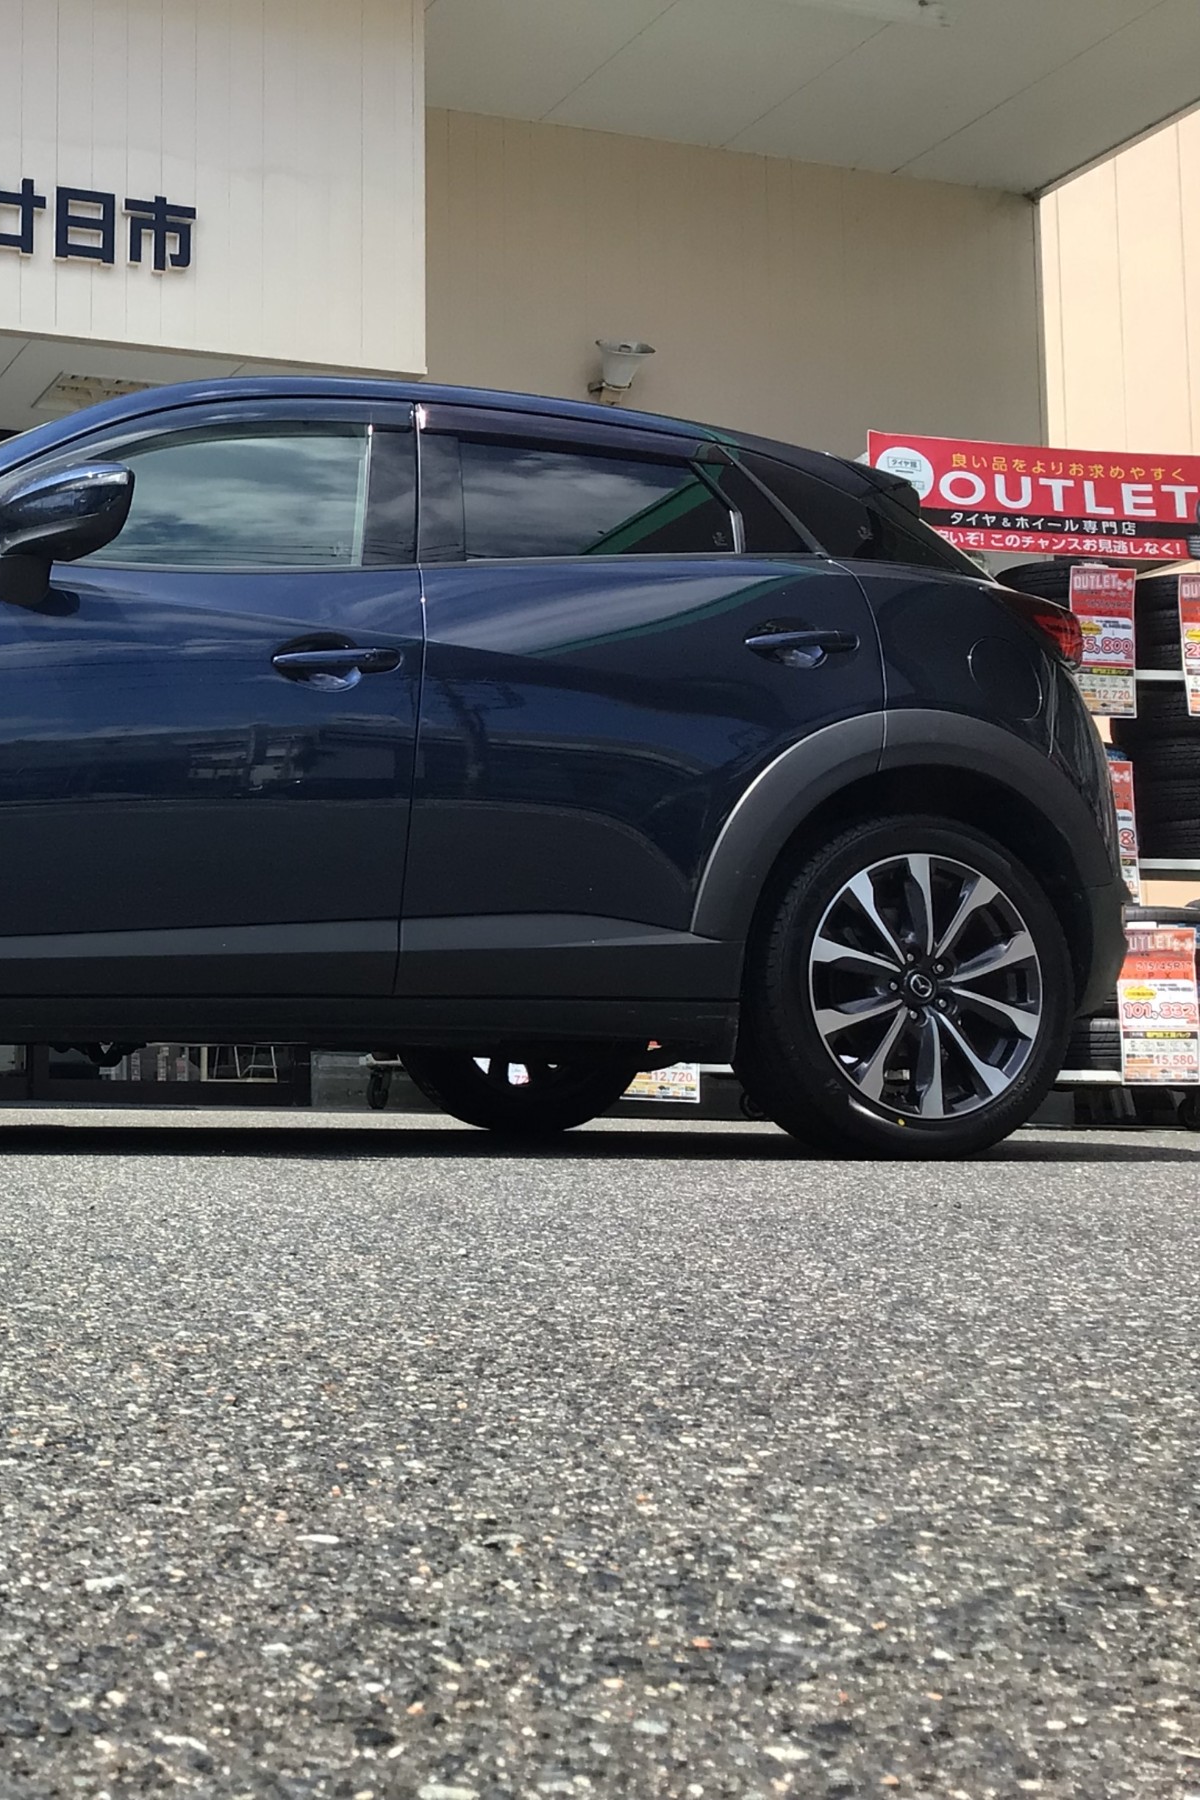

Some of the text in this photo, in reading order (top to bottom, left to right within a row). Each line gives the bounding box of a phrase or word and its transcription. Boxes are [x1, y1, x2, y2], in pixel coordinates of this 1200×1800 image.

[951, 452, 1185, 482] 良い品をよりお求めやすく
[939, 470, 1198, 519] OUTLET
[990, 533, 1181, 555] このチャンスお見逃しなく!
[1082, 636, 1133, 654] 5,800
[1123, 1002, 1197, 1020] 101,332
[653, 1071, 693, 1083] 12,720
